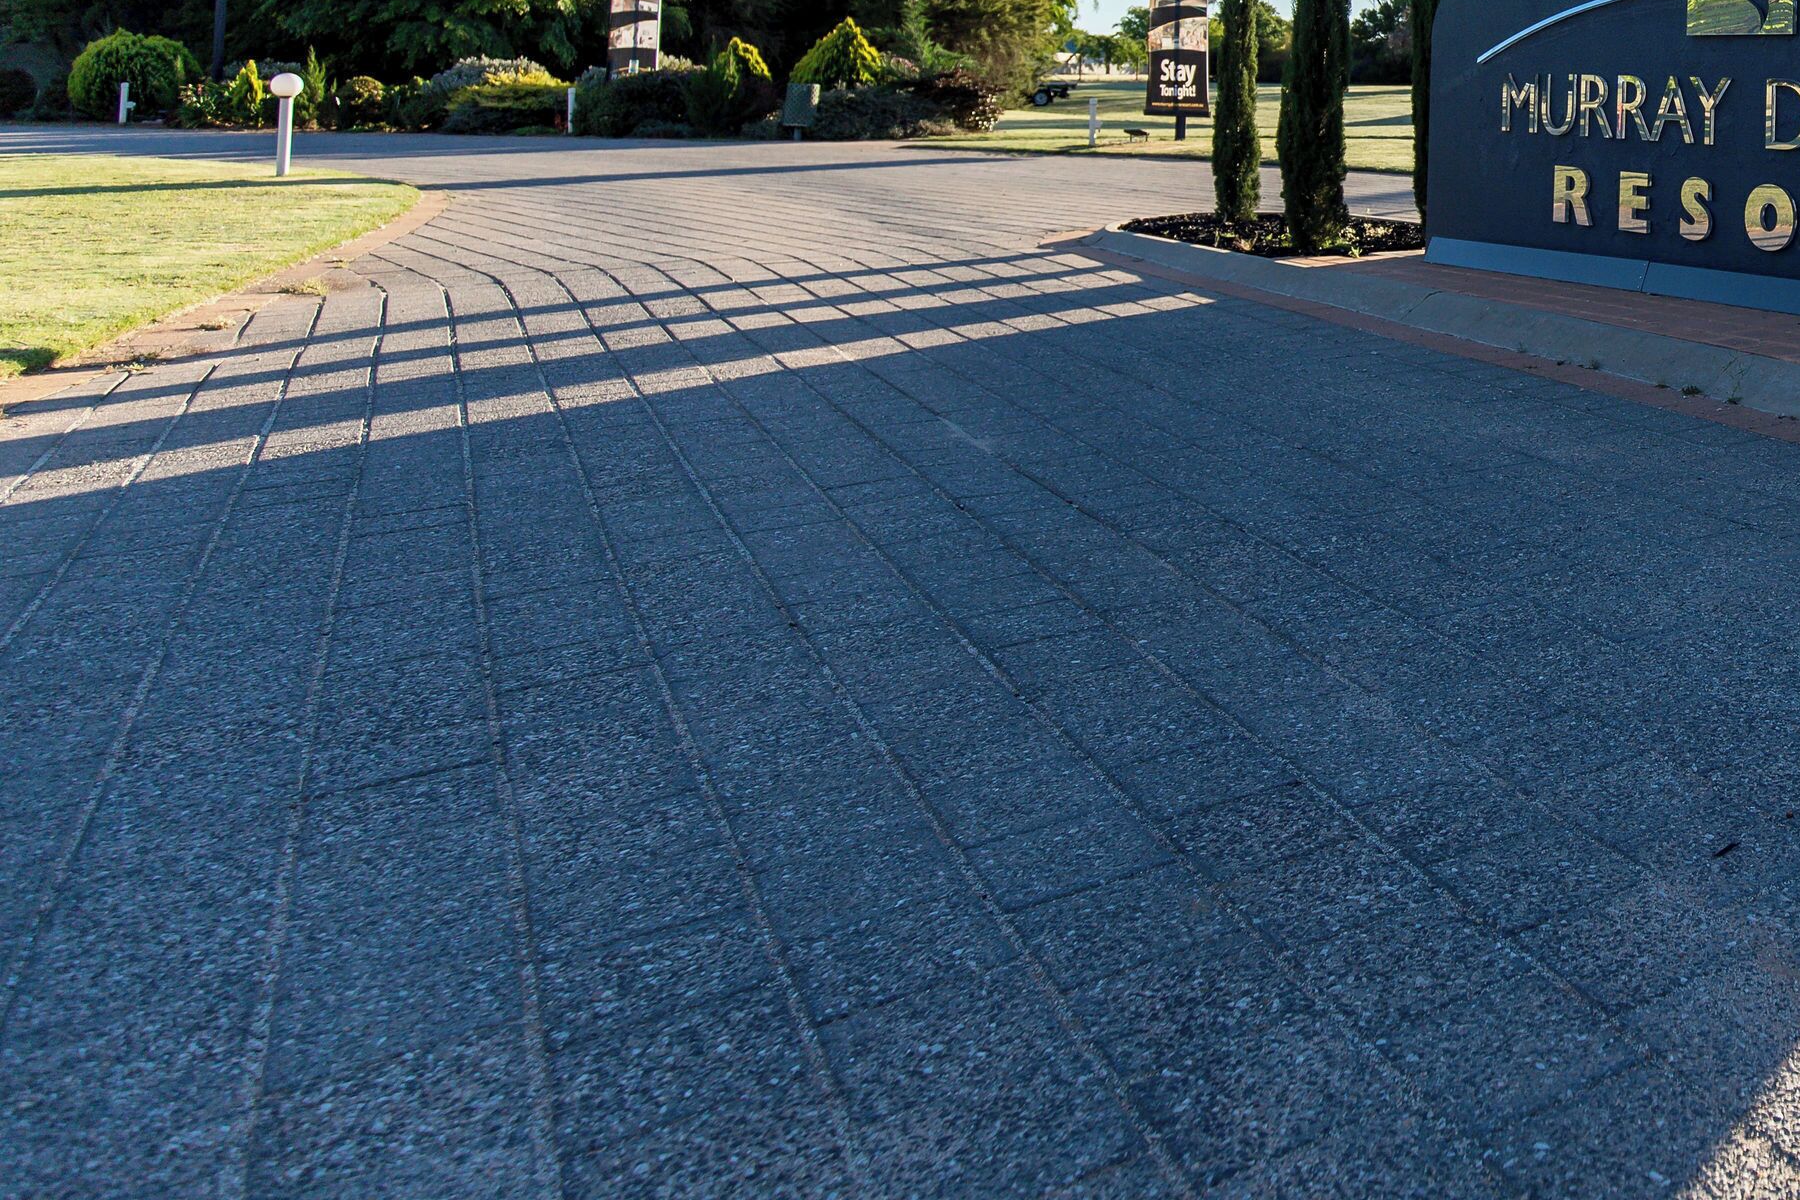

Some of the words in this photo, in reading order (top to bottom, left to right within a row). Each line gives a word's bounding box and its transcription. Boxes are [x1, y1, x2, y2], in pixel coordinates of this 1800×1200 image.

[1160, 58, 1197, 88] Stay
[1159, 84, 1197, 100] Tonight!
[1501, 72, 1733, 146] MURRAY
